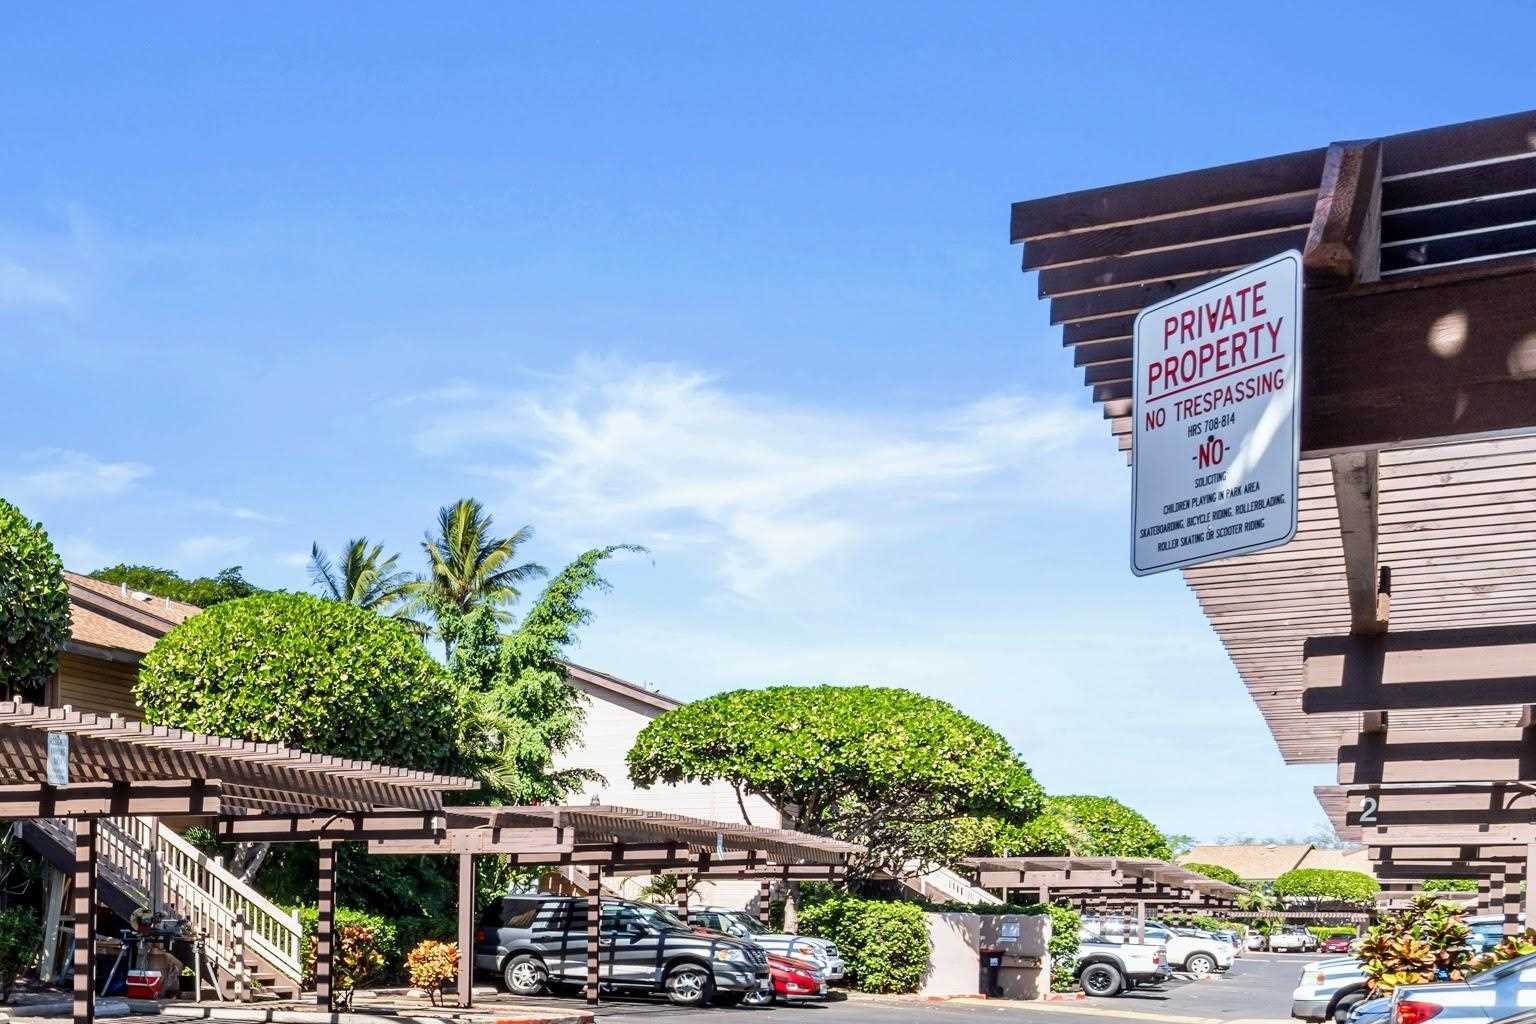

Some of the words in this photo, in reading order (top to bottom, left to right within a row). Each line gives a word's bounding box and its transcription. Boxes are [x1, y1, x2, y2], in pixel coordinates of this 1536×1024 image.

[1164, 281, 1267, 351] PRIVATE
[1148, 316, 1284, 396] PROPERTY
[1145, 408, 1166, 432] NO
[1174, 369, 1284, 421] TRESPASSING
[1187, 422, 1202, 438] HRS
[1204, 412, 1236, 432] 708-814
[1194, 471, 1227, 489] SOLICITING
[1163, 500, 1190, 515] CHILDREN
[1191, 492, 1217, 508] PLAYING
[1218, 491, 1224, 501] IN
[1225, 486, 1242, 500] PARK
[1243, 481, 1260, 495] AREA
[1157, 538, 1179, 552] ROLLER
[1180, 532, 1205, 547] SKATING
[1206, 530, 1214, 541] OR
[1216, 523, 1243, 539] SCOOTER
[1244, 518, 1265, 532] RIDING
[1186, 512, 1211, 527] BICYCLE
[1359, 797, 1377, 822] 2
